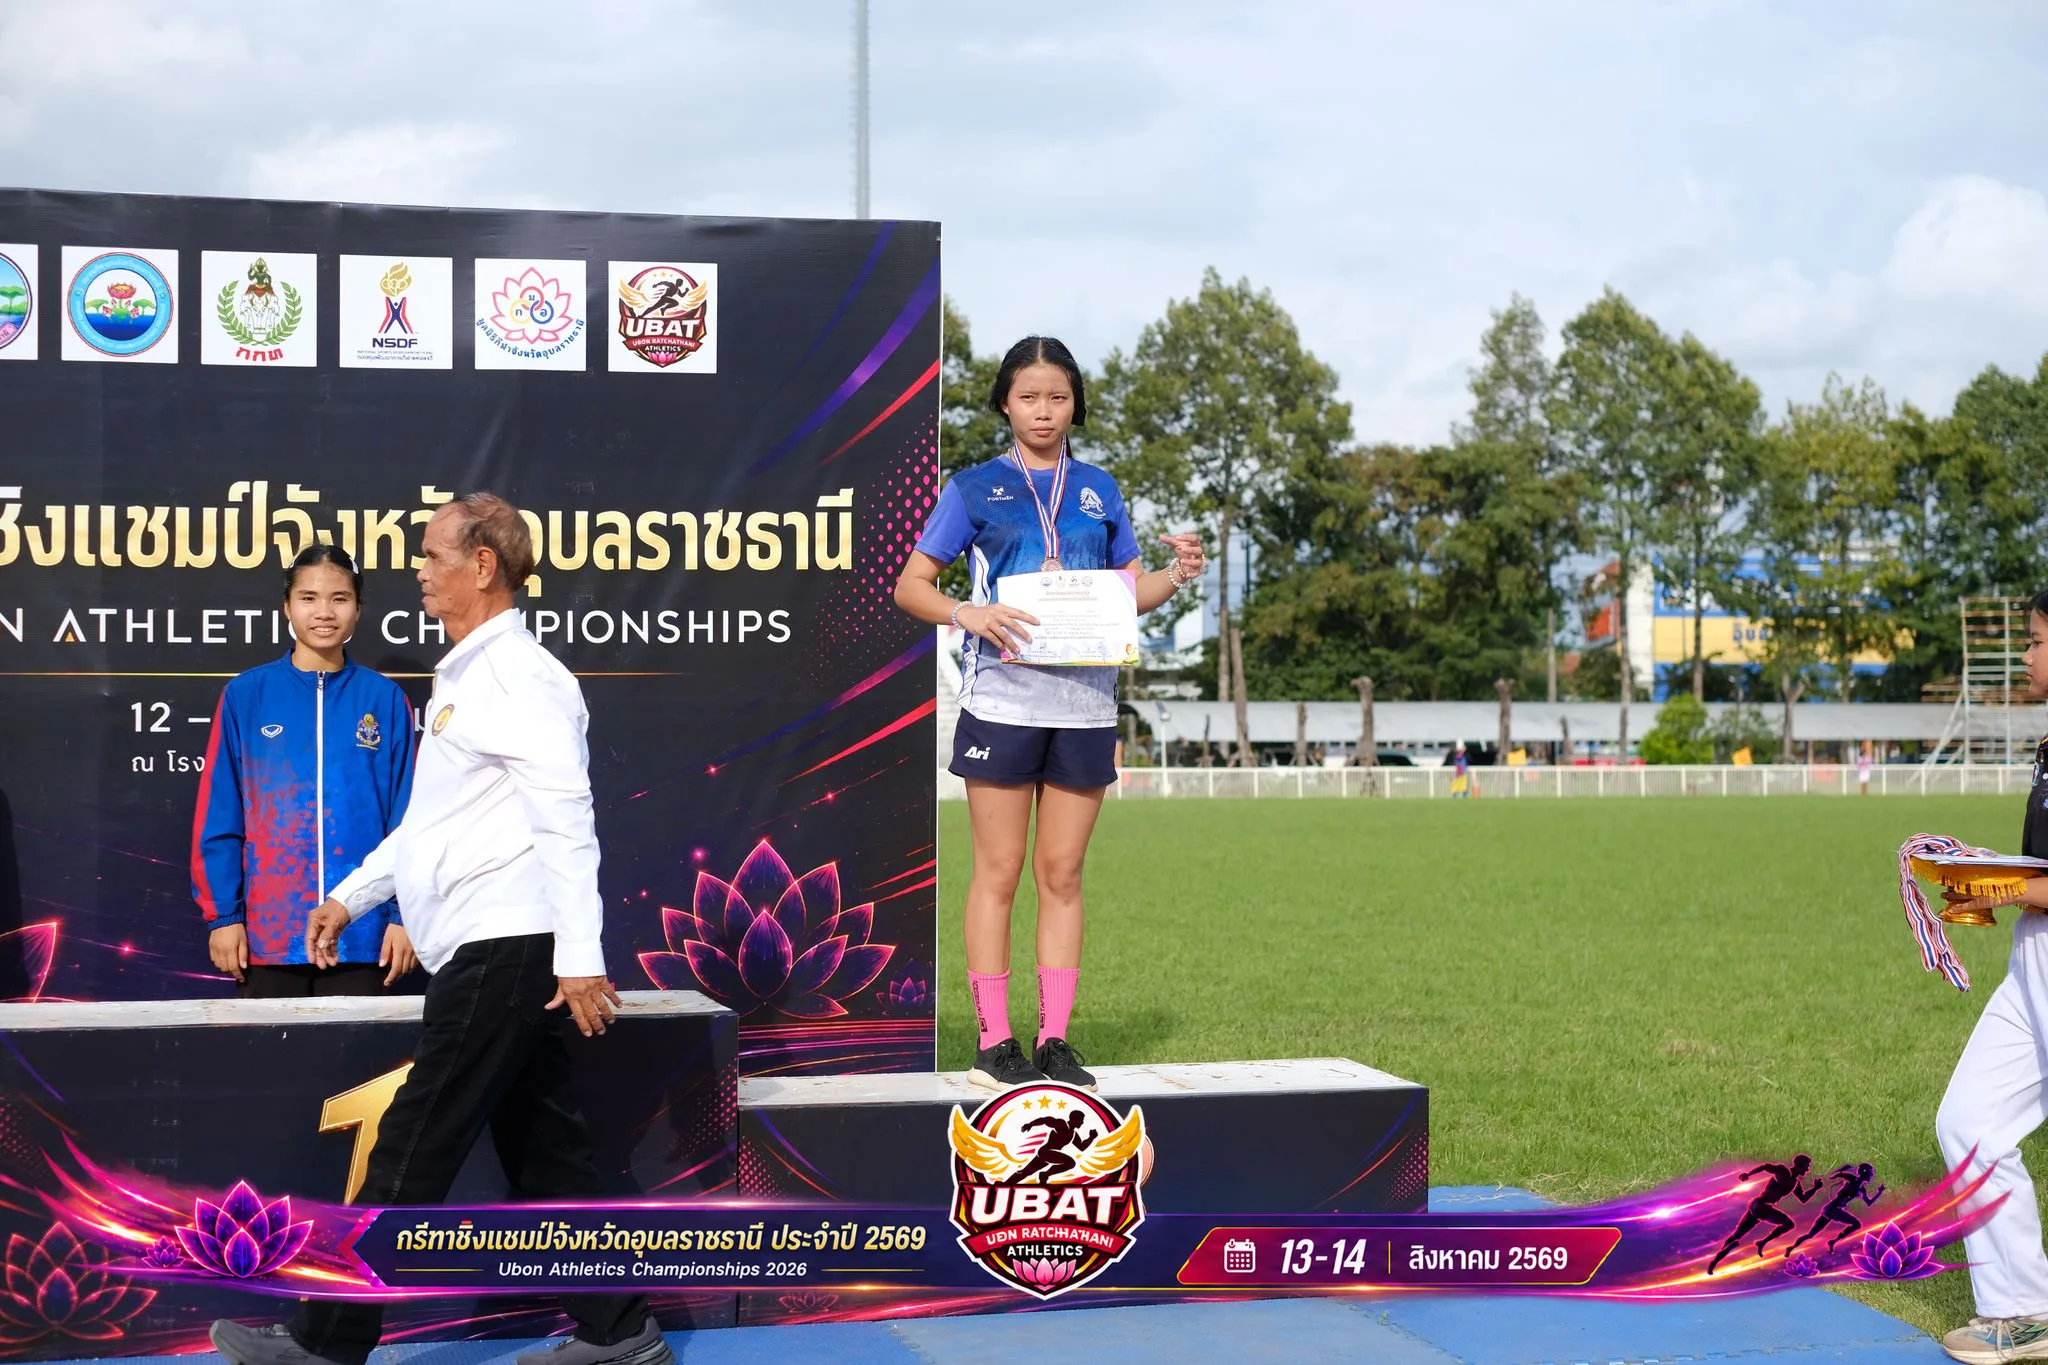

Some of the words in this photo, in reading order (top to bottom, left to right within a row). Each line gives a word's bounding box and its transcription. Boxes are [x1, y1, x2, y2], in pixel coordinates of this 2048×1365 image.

[625, 317, 701, 339] UBAT
[372, 337, 418, 349] NSDF
[632, 338, 651, 347] UBON
[52, 608, 353, 645] ATHLETI
[380, 609, 791, 645] CHPIONSHIPS
[131, 701, 171, 733] 12
[963, 746, 991, 760] Ari
[131, 756, 154, 772] ณ
